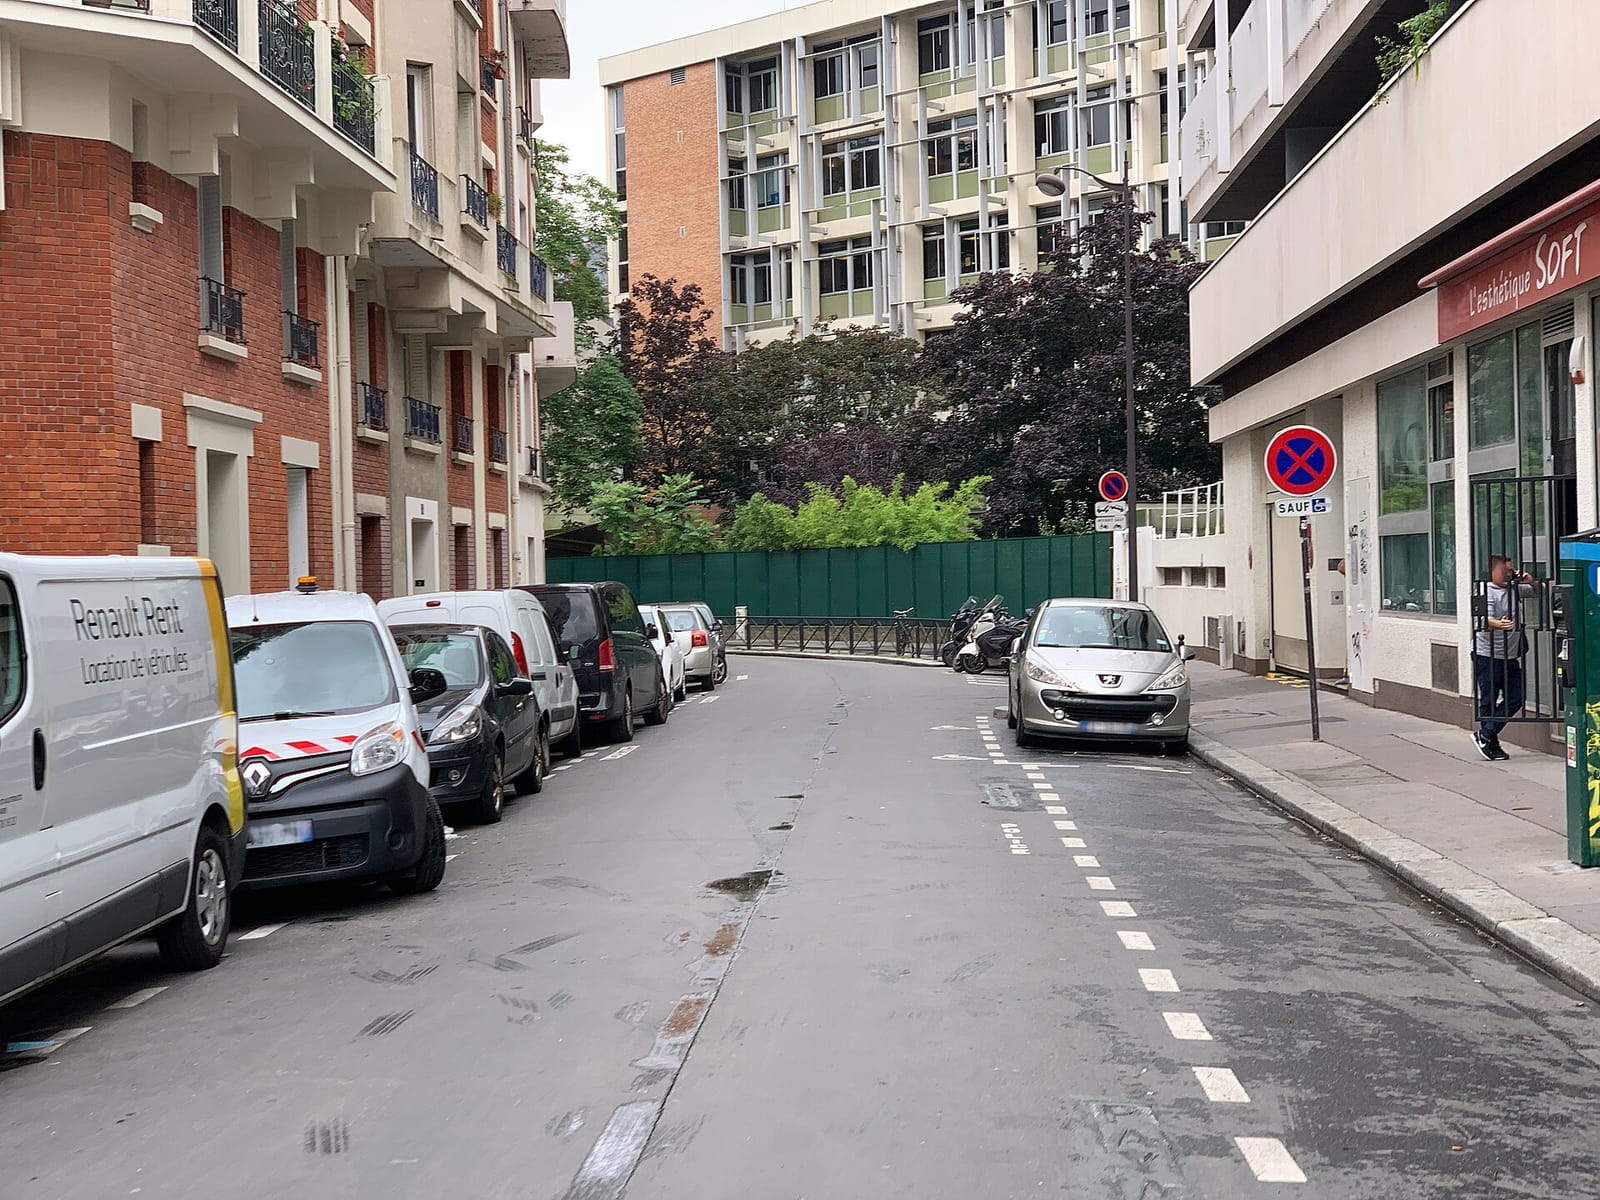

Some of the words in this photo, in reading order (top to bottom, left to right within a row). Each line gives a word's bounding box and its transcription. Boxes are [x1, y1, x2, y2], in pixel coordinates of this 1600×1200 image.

[1469, 267, 1531, 316] L'esthétique
[1535, 222, 1588, 290] SOFT
[1278, 501, 1310, 513] SAUF
[69, 596, 143, 640] Renault
[141, 597, 184, 636] Rent
[80, 653, 130, 685] Location
[130, 651, 145, 678] de
[144, 646, 189, 676] véhicules
